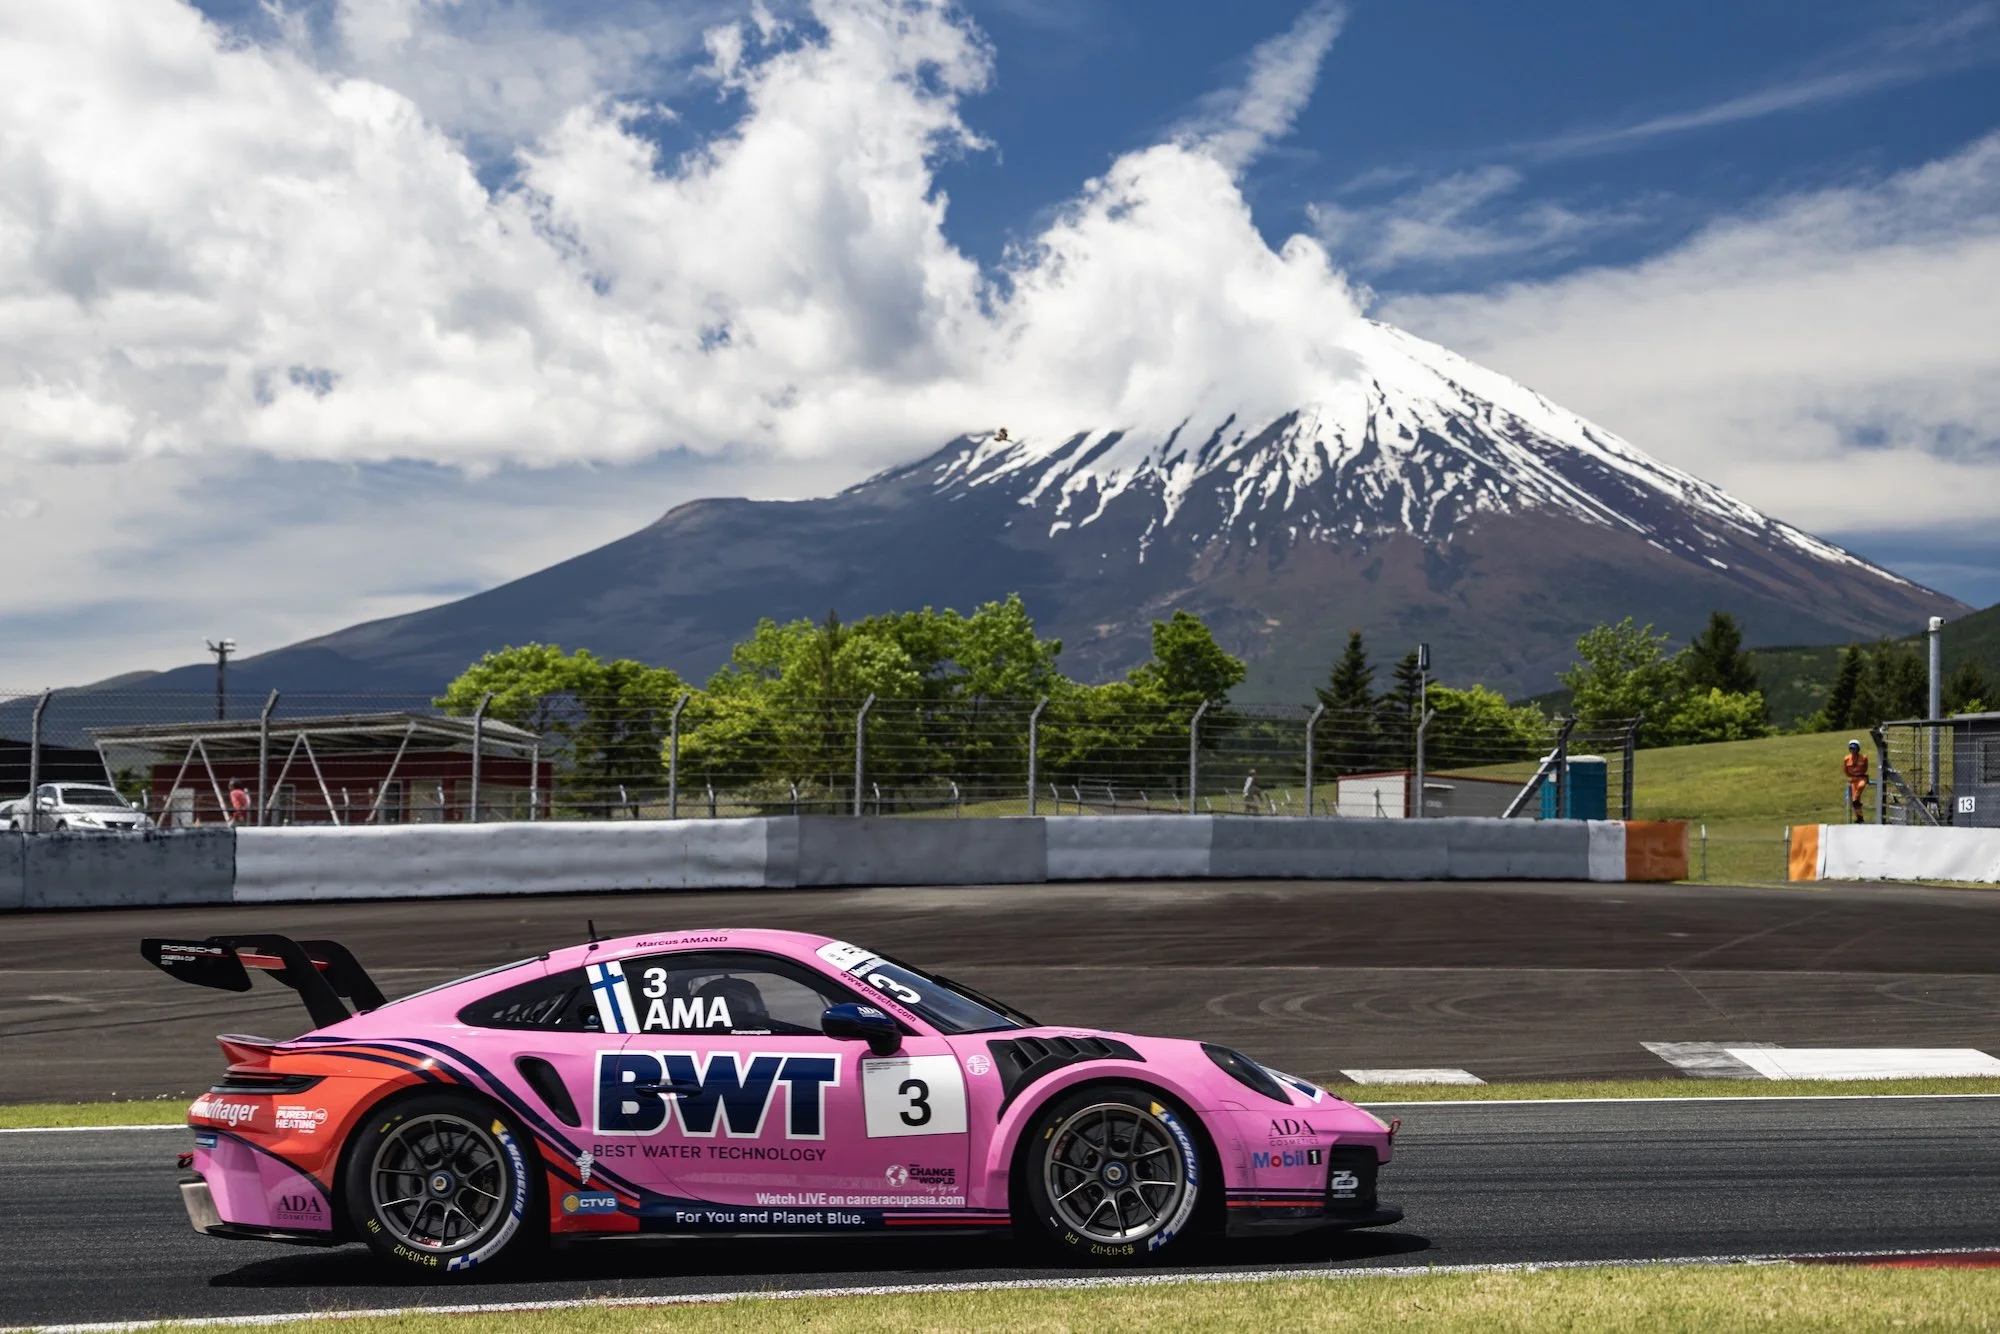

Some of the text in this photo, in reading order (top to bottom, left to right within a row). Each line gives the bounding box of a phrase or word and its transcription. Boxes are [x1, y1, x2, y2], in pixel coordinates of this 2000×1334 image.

[1961, 799, 1972, 811] 13
[161, 944, 222, 954] PORSCHE
[636, 939, 678, 948] Marcus
[642, 967, 668, 998] 3
[868, 974, 922, 1004] 3
[840, 972, 916, 1022] www.porsche.com
[643, 996, 733, 1030] AMA
[595, 1051, 840, 1138] BWT
[898, 1079, 932, 1126] 3
[276, 1110, 314, 1120] PUREST
[276, 1120, 316, 1128] HEATING
[1268, 1118, 1317, 1136] ADA
[593, 1144, 827, 1161] BEST WATER TECHNOLOGY
[1168, 1120, 1196, 1180] MICHELIN
[1253, 1150, 1304, 1168] Mobil
[507, 1144, 526, 1214] MICHELIN
[910, 1167, 956, 1177] CHANGE
[277, 1195, 322, 1212] ADA
[580, 1198, 616, 1208] CTVS
[756, 1192, 965, 1208] Watch LIVE on carreracupasia.com
[676, 1211, 866, 1224] For You and Planet Blue.
[394, 1244, 438, 1266] #3-03-02
